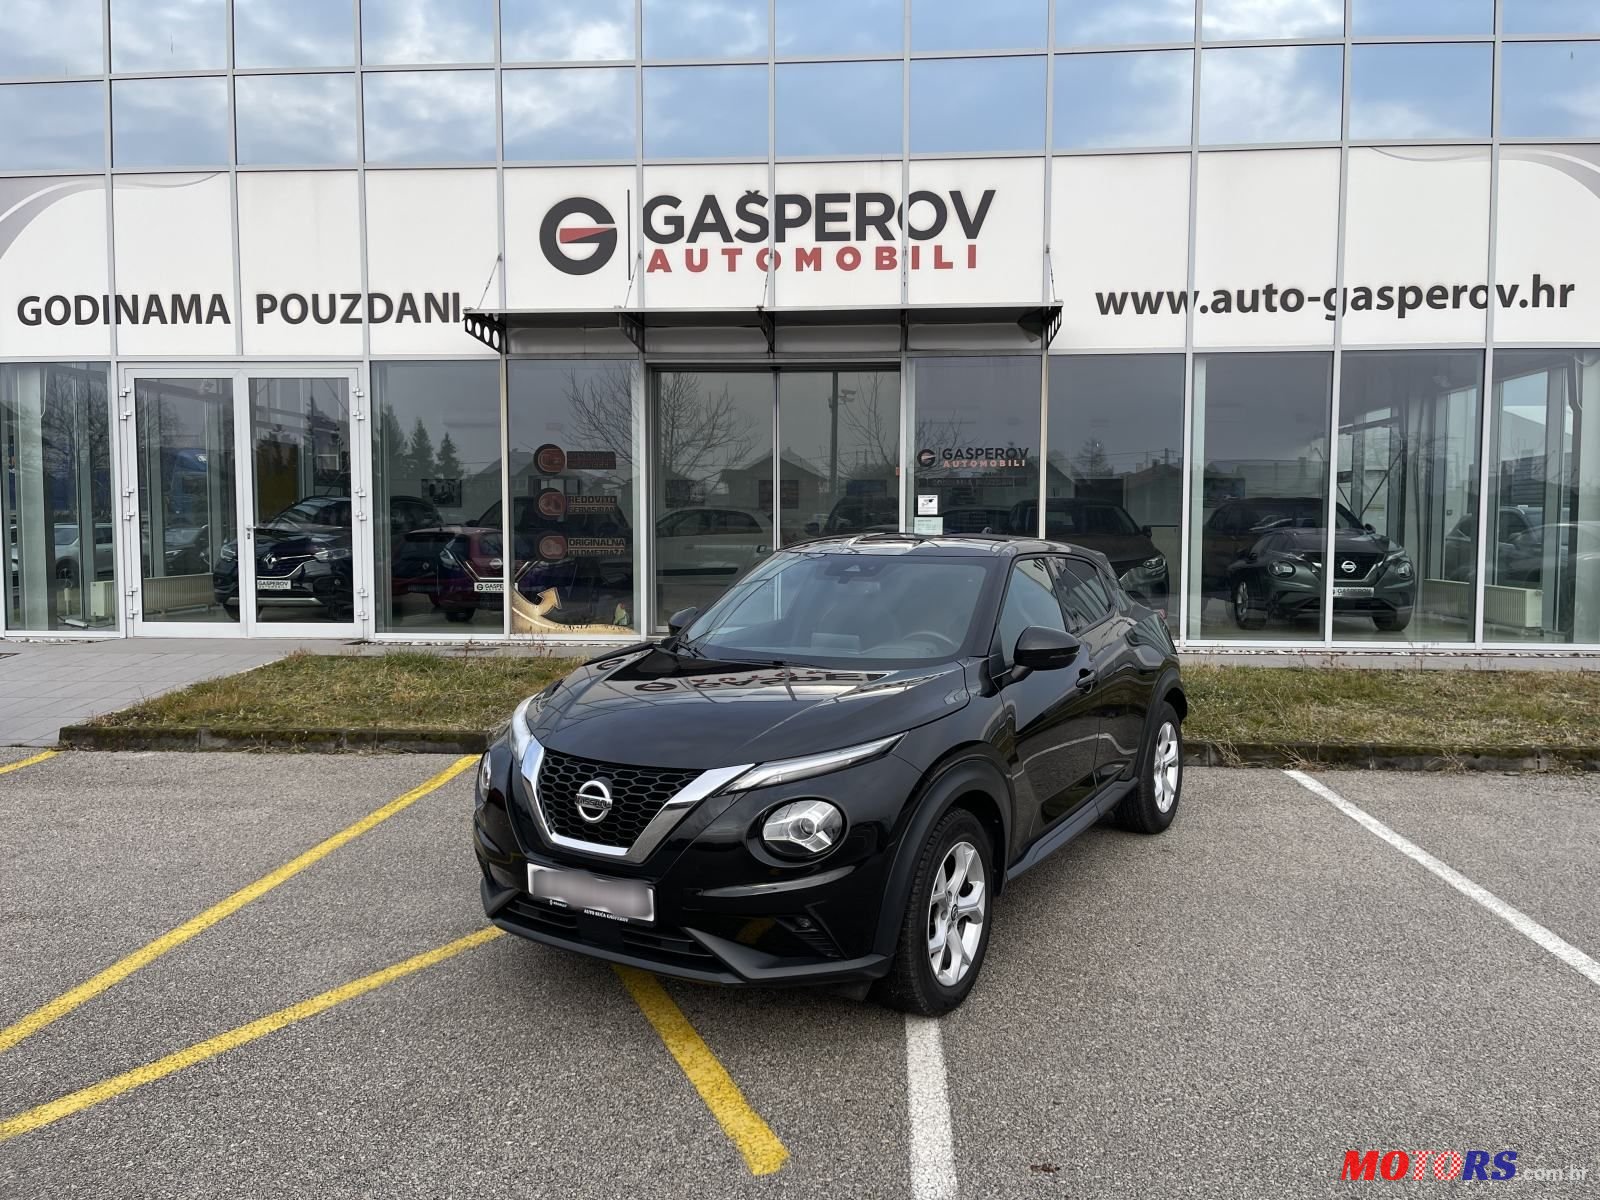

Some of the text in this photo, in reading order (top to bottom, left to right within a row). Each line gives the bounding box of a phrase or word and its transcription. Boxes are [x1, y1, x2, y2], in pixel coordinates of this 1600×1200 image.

[642, 189, 997, 245] GAŠPEROV
[646, 244, 977, 274] AUTOMOBILI
[1095, 274, 1576, 321] www.auto-gasperov.hr
[17, 292, 461, 326] GODINAMA POUZDANI
[943, 459, 1026, 468] AUTOMOBILI
[568, 495, 616, 504] REDOVITO
[568, 538, 625, 547] ORIGINALNA
[576, 795, 608, 808] NISSAN
